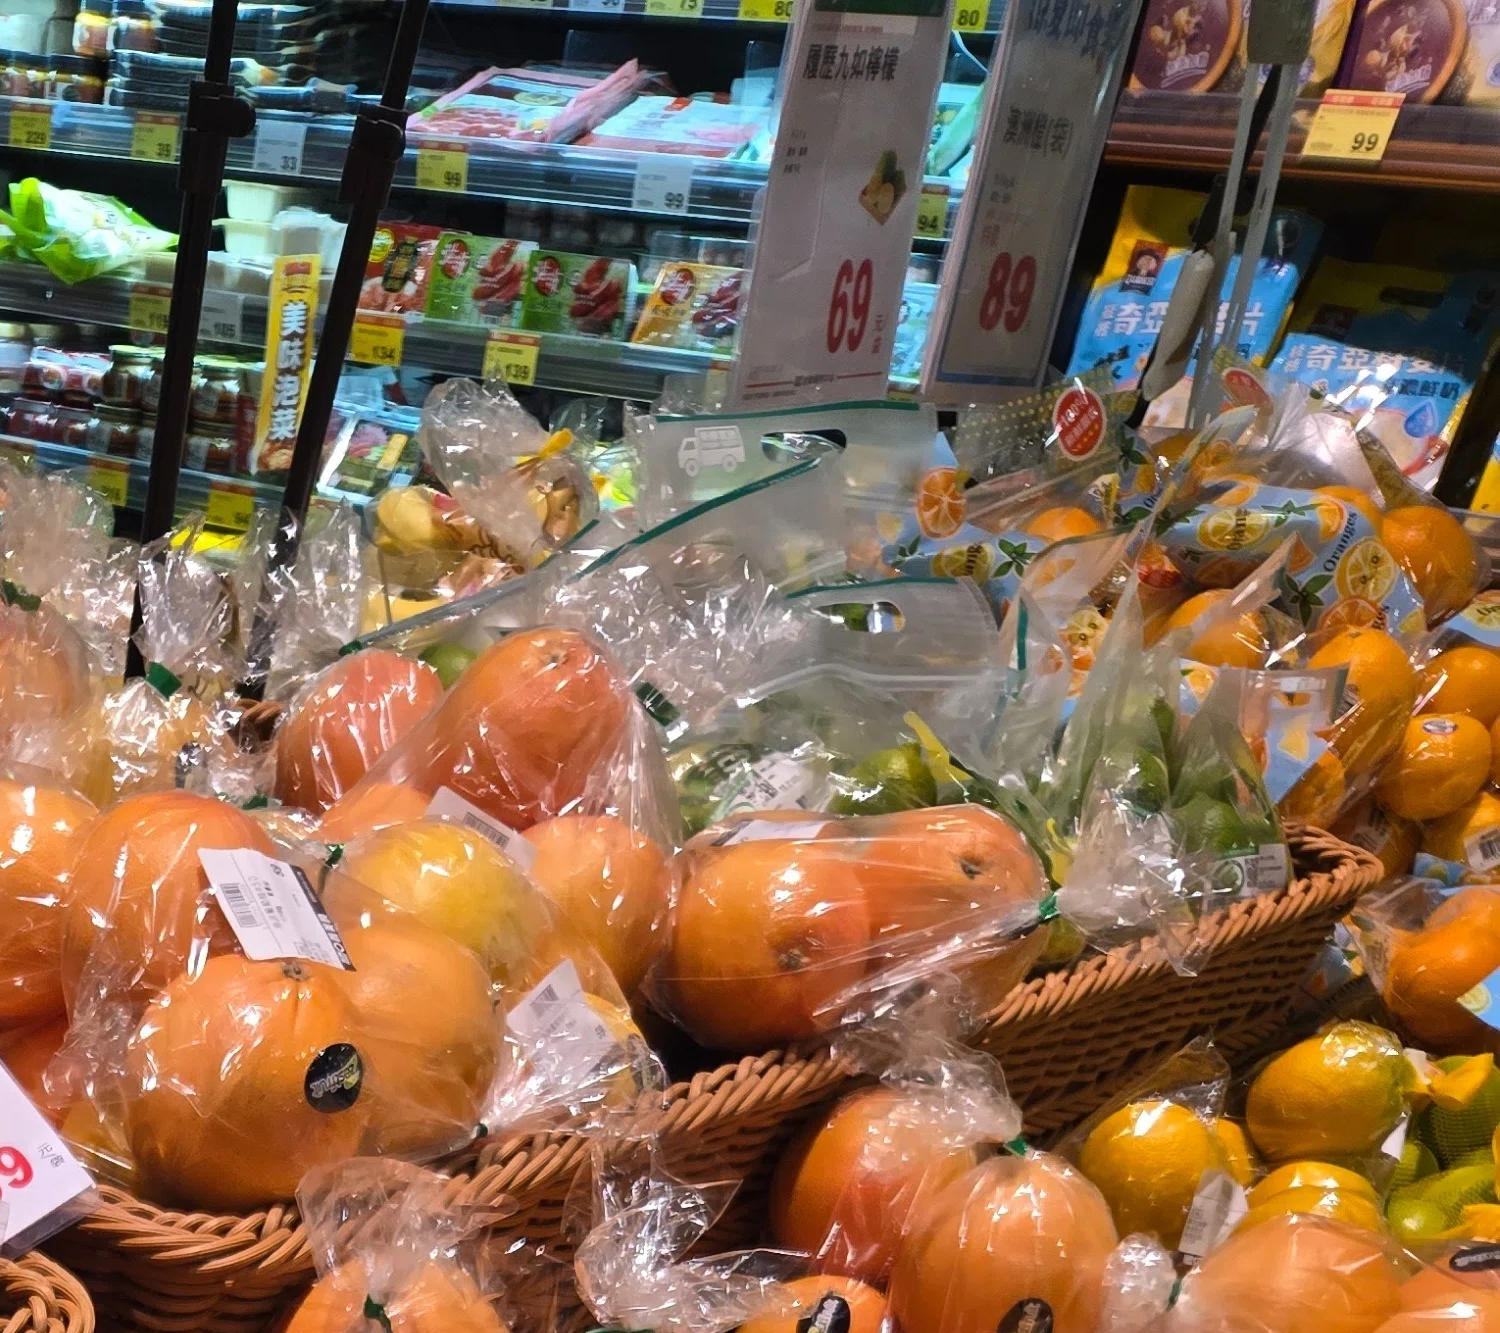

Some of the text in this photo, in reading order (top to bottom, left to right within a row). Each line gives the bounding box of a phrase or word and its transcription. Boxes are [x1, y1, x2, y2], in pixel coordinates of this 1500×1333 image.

[1351, 132, 1380, 152] 99
[826, 257, 874, 354] 69
[978, 250, 1038, 334] 89
[269, 299, 308, 441] 美味泡菜
[1322, 510, 1359, 574] Oranges
